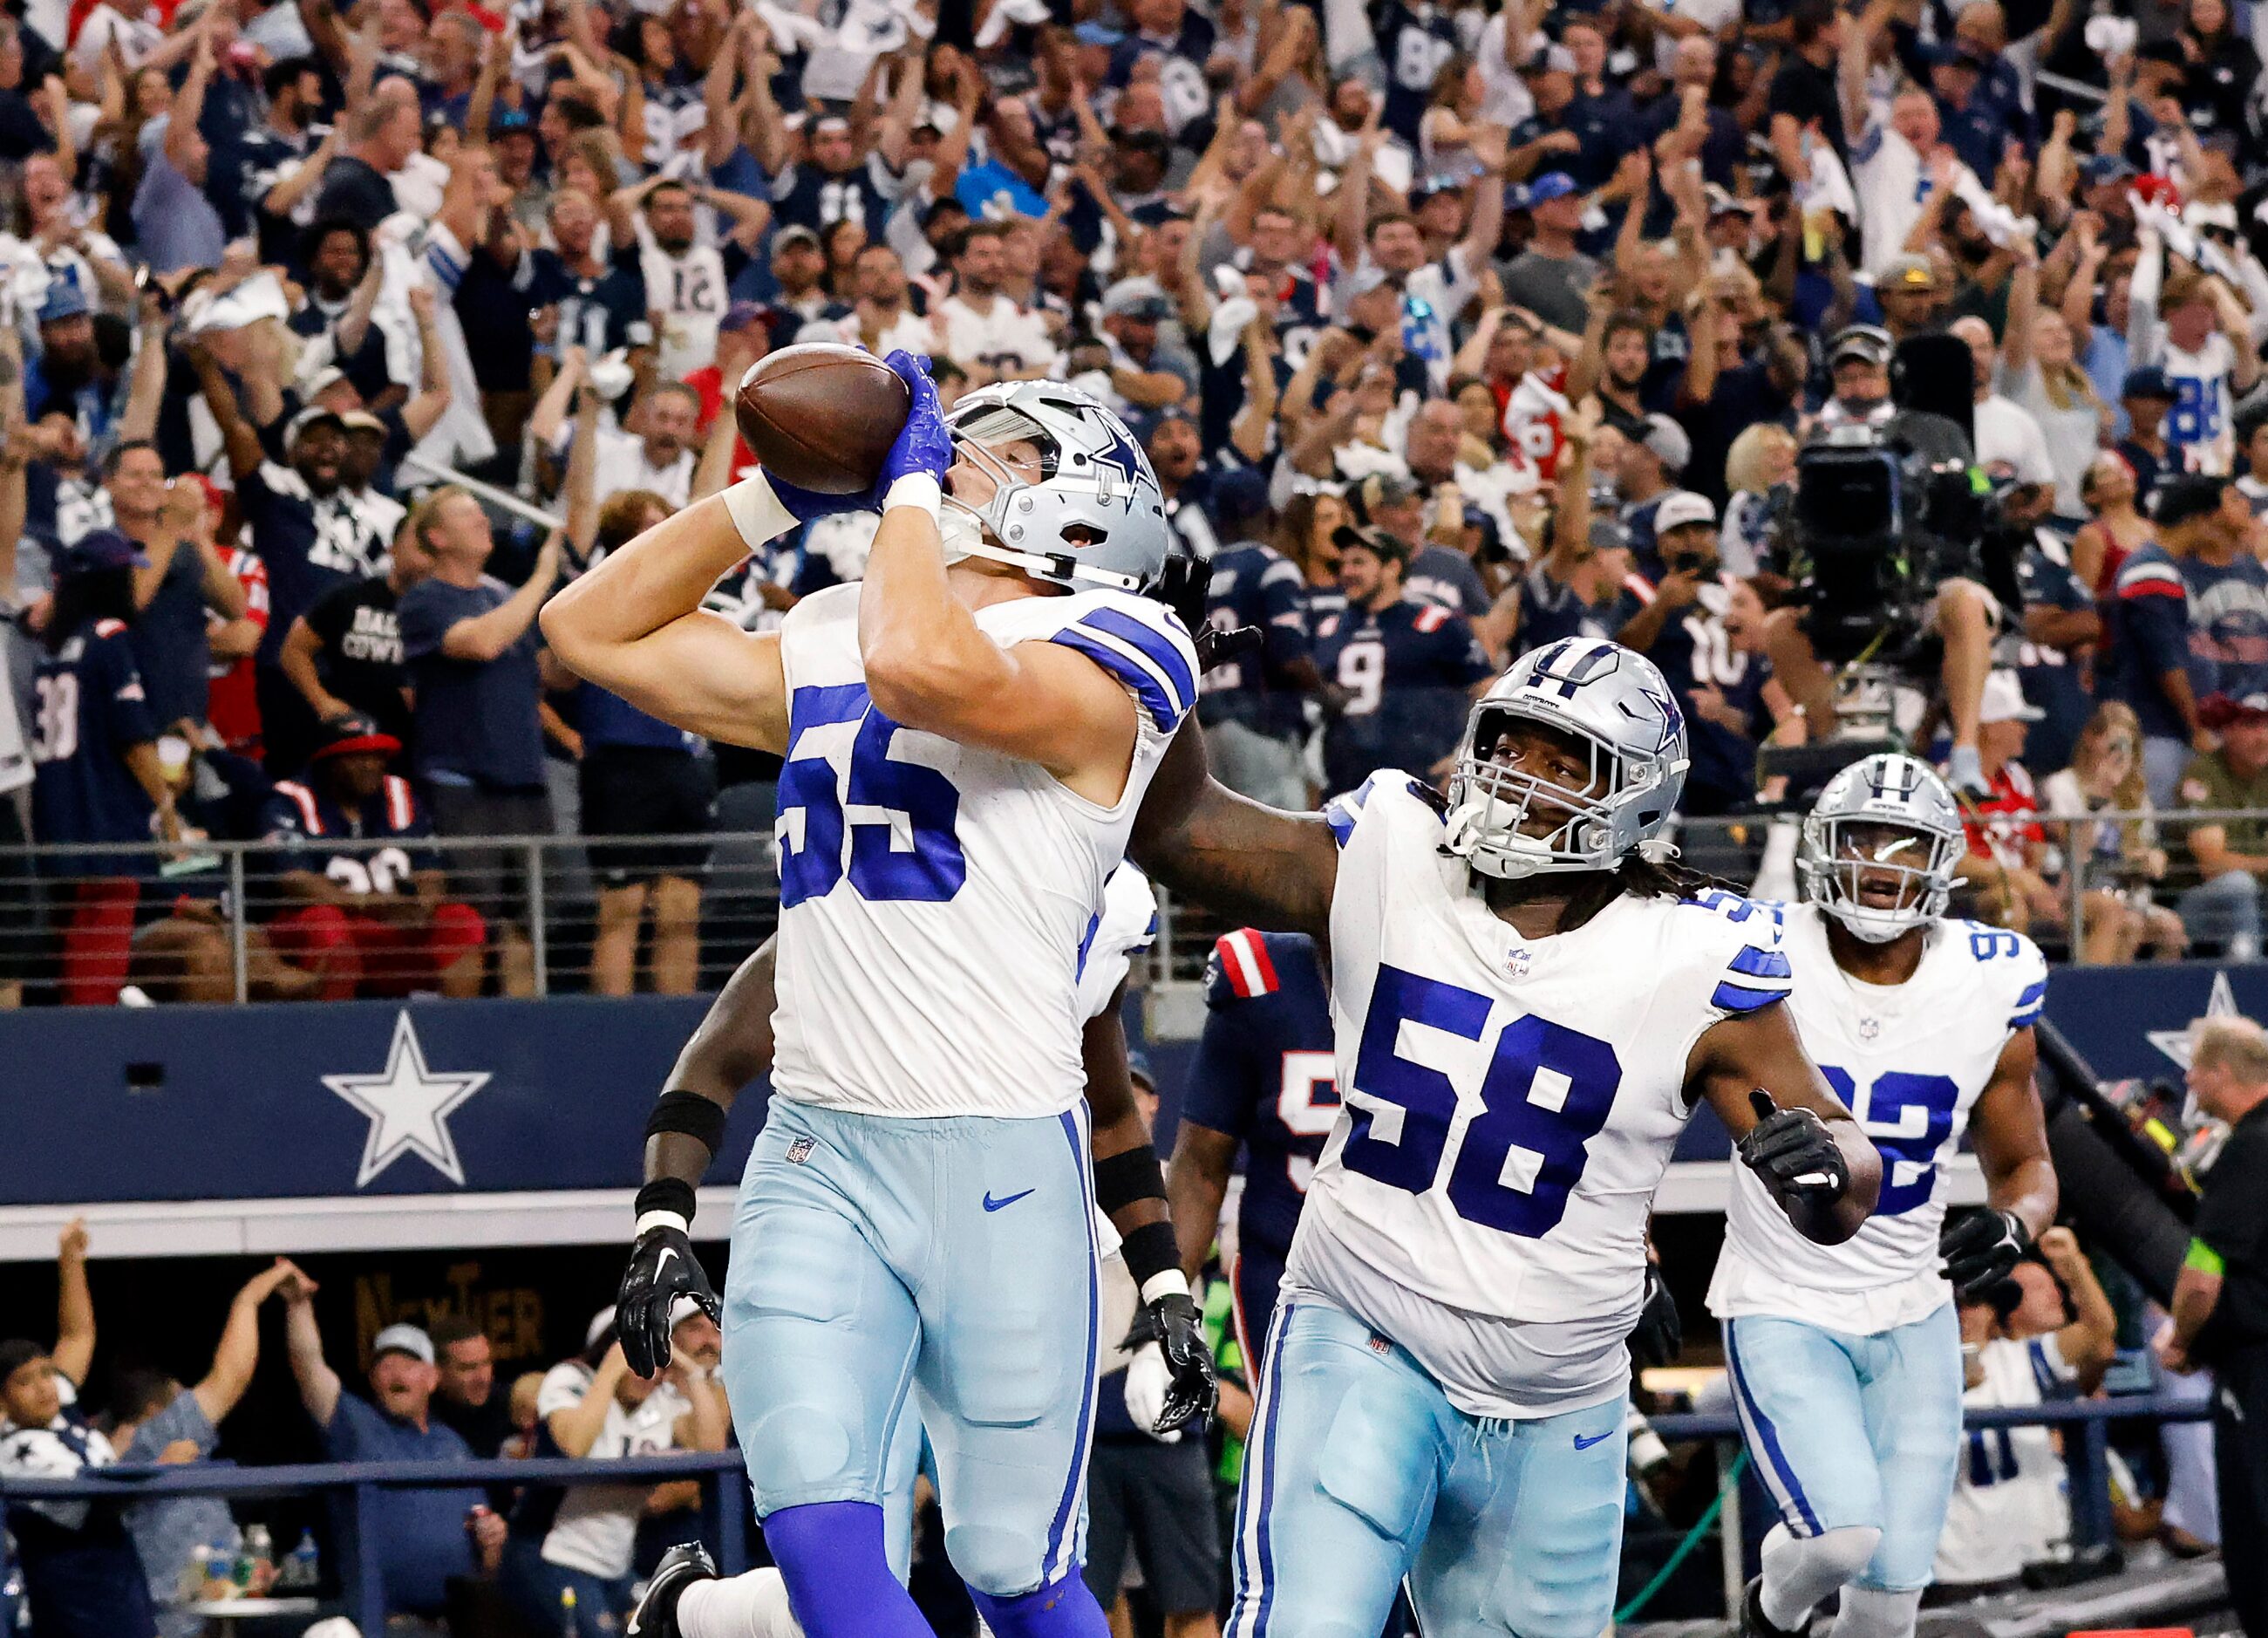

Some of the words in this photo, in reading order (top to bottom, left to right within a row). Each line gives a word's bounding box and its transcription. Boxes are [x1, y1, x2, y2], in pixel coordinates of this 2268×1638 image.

[1338, 642, 1385, 716] 9
[774, 682, 972, 910] 55
[1341, 961, 1624, 1239] 58
[1816, 1063, 1960, 1217] 2
